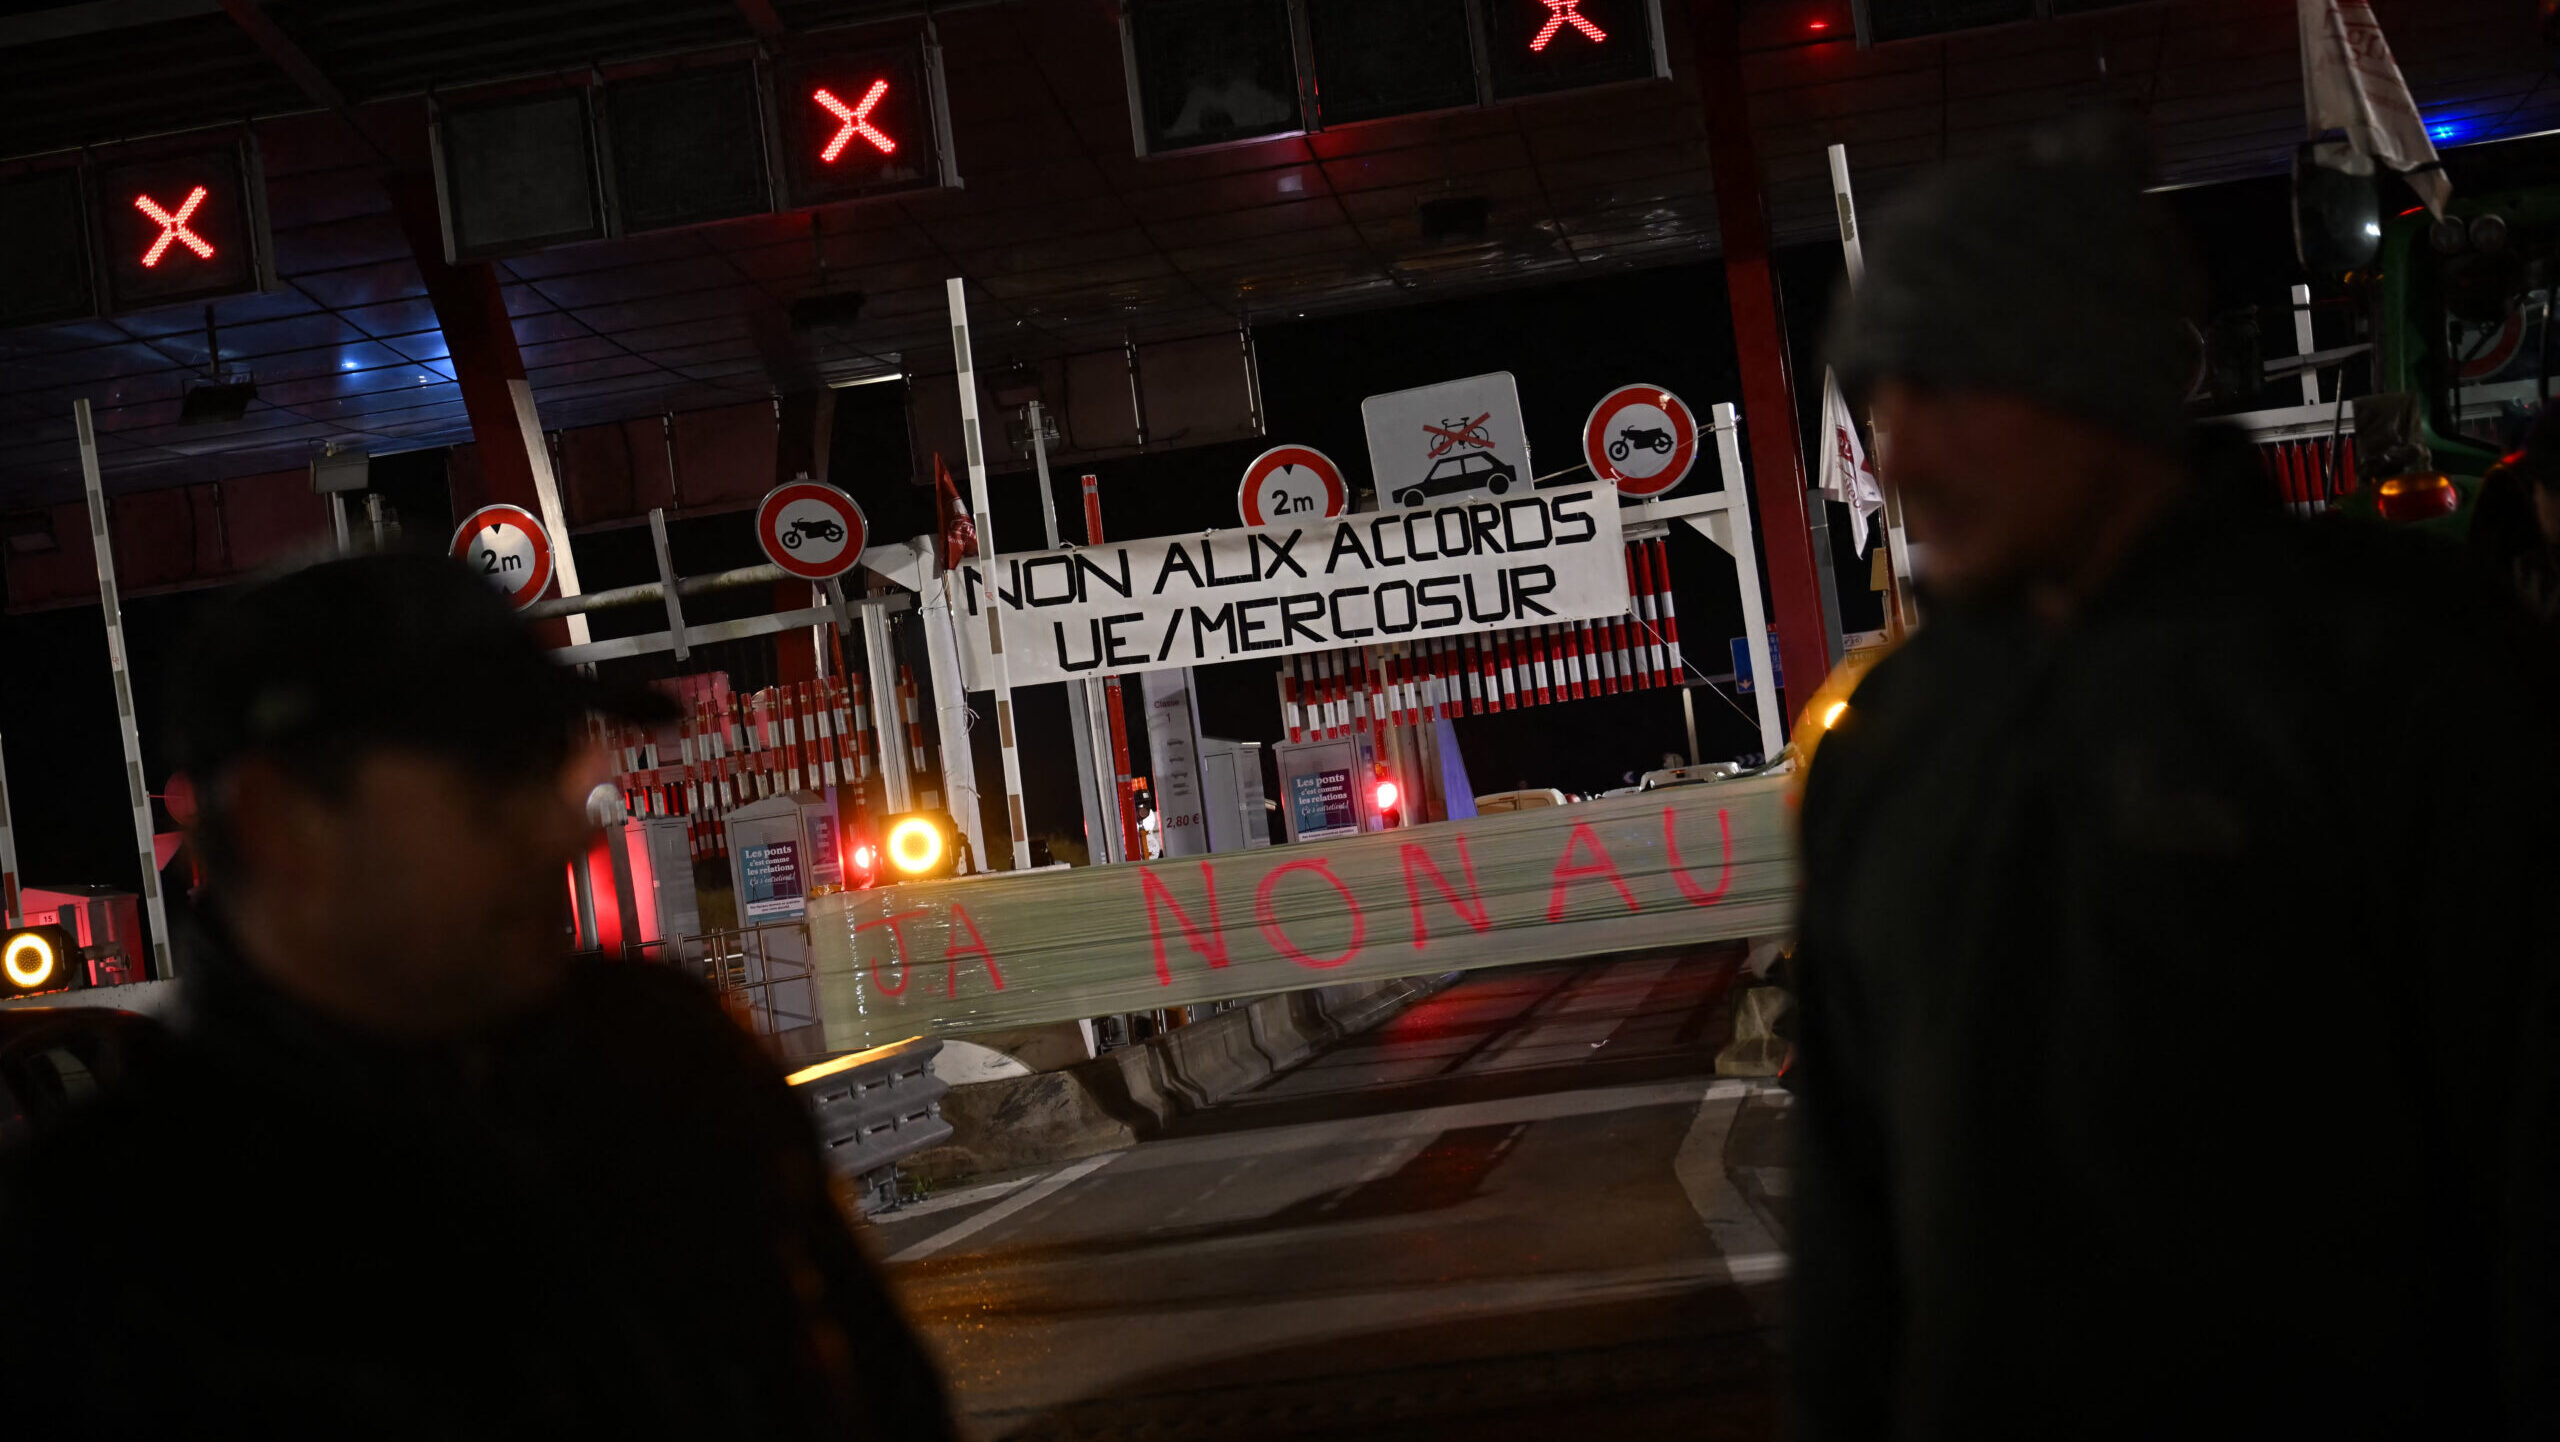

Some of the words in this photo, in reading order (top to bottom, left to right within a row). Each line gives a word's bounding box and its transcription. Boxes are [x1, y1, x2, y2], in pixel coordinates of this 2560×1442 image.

[963, 549, 1133, 616] NON
[1152, 529, 1308, 595] AUX
[1325, 490, 1597, 574] ACCORDS
[1053, 564, 1558, 672] UE/MERCOSUR
[1154, 699, 1181, 709] Classe
[1296, 778, 1314, 788] Les
[1315, 773, 1345, 787] ponts
[1318, 785, 1344, 794] comme
[1299, 797, 1311, 805] les
[1312, 793, 1348, 803] relations
[1166, 815, 1190, 829] 2,80
[1192, 813, 1200, 825] €
[745, 850, 762, 859] Les
[764, 845, 793, 858] ponts
[766, 857, 790, 865] comme
[747, 868, 758, 876] les
[760, 864, 795, 874] relations
[1138, 831, 1492, 987] NON
[1546, 806, 1733, 922] AU
